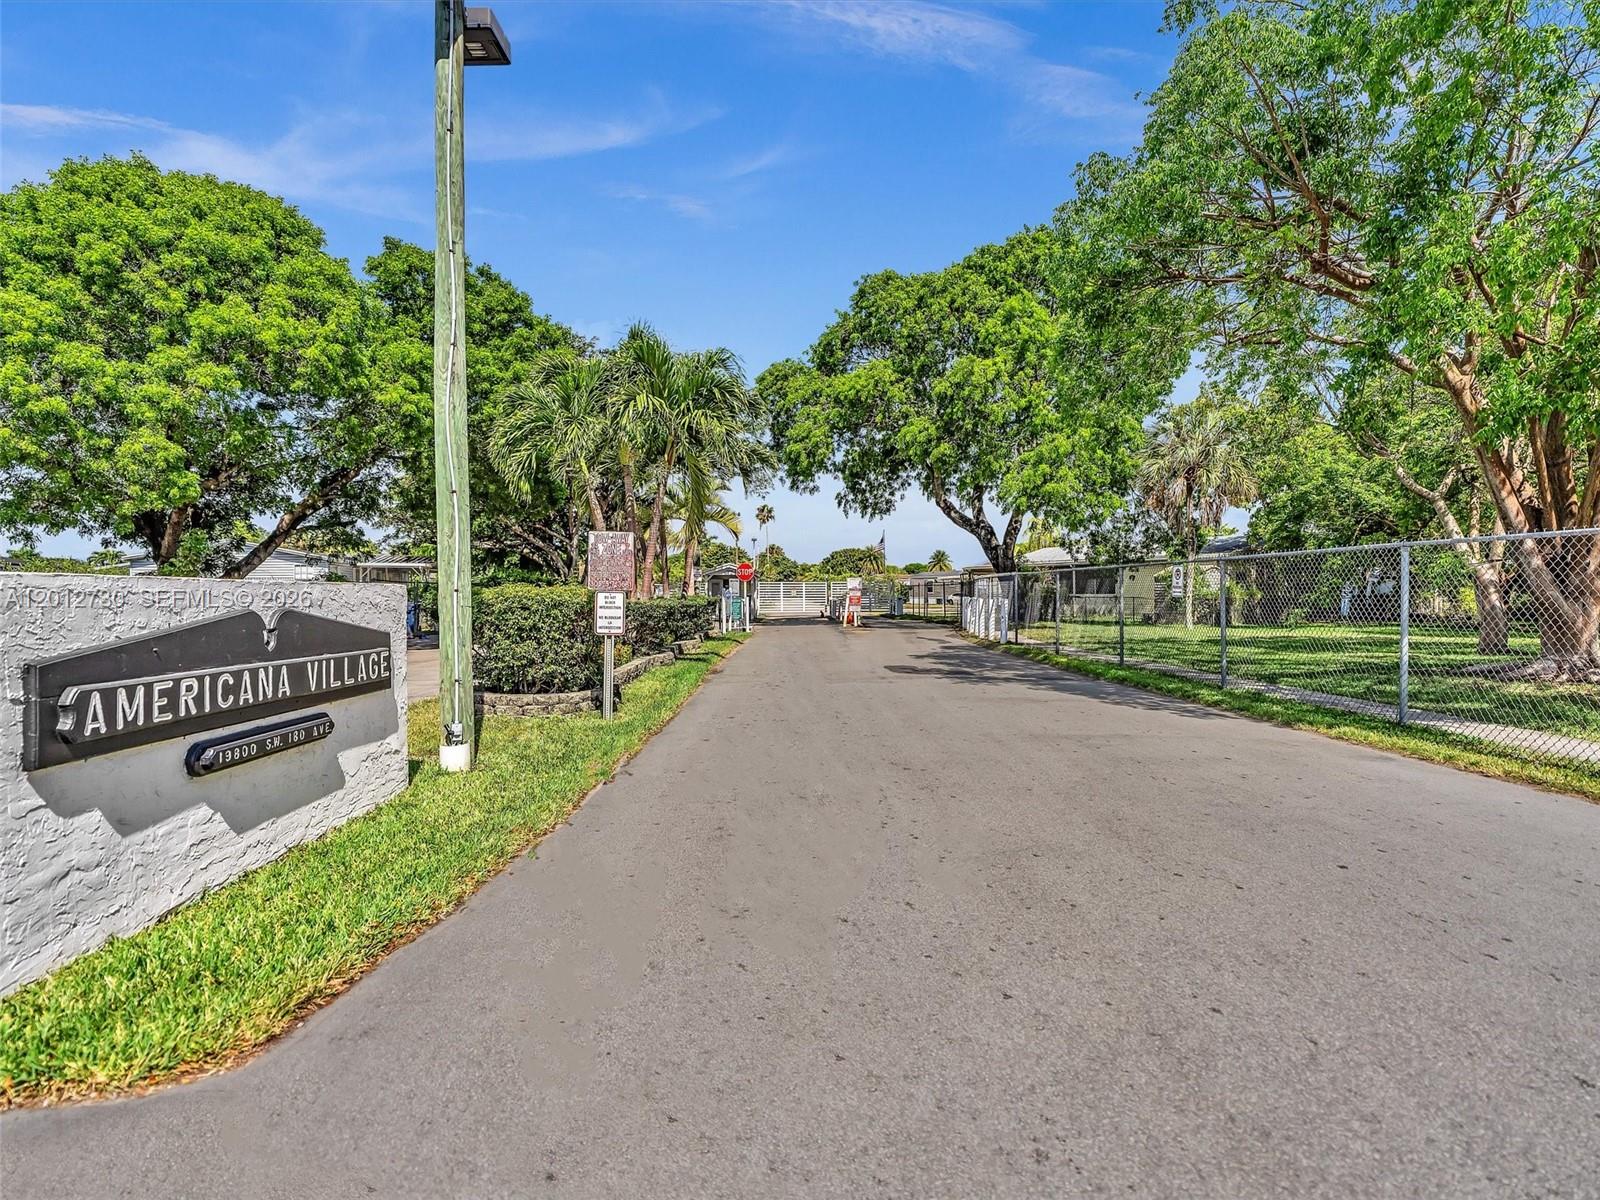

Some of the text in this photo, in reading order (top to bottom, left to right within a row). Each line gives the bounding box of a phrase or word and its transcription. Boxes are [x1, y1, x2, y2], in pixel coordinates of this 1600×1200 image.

[737, 568, 753, 576] STOP
[84, 651, 390, 737] AMERICANA VILLAGE
[219, 743, 257, 764] 19800
[265, 735, 283, 750] S.W.
[288, 729, 305, 743] 180
